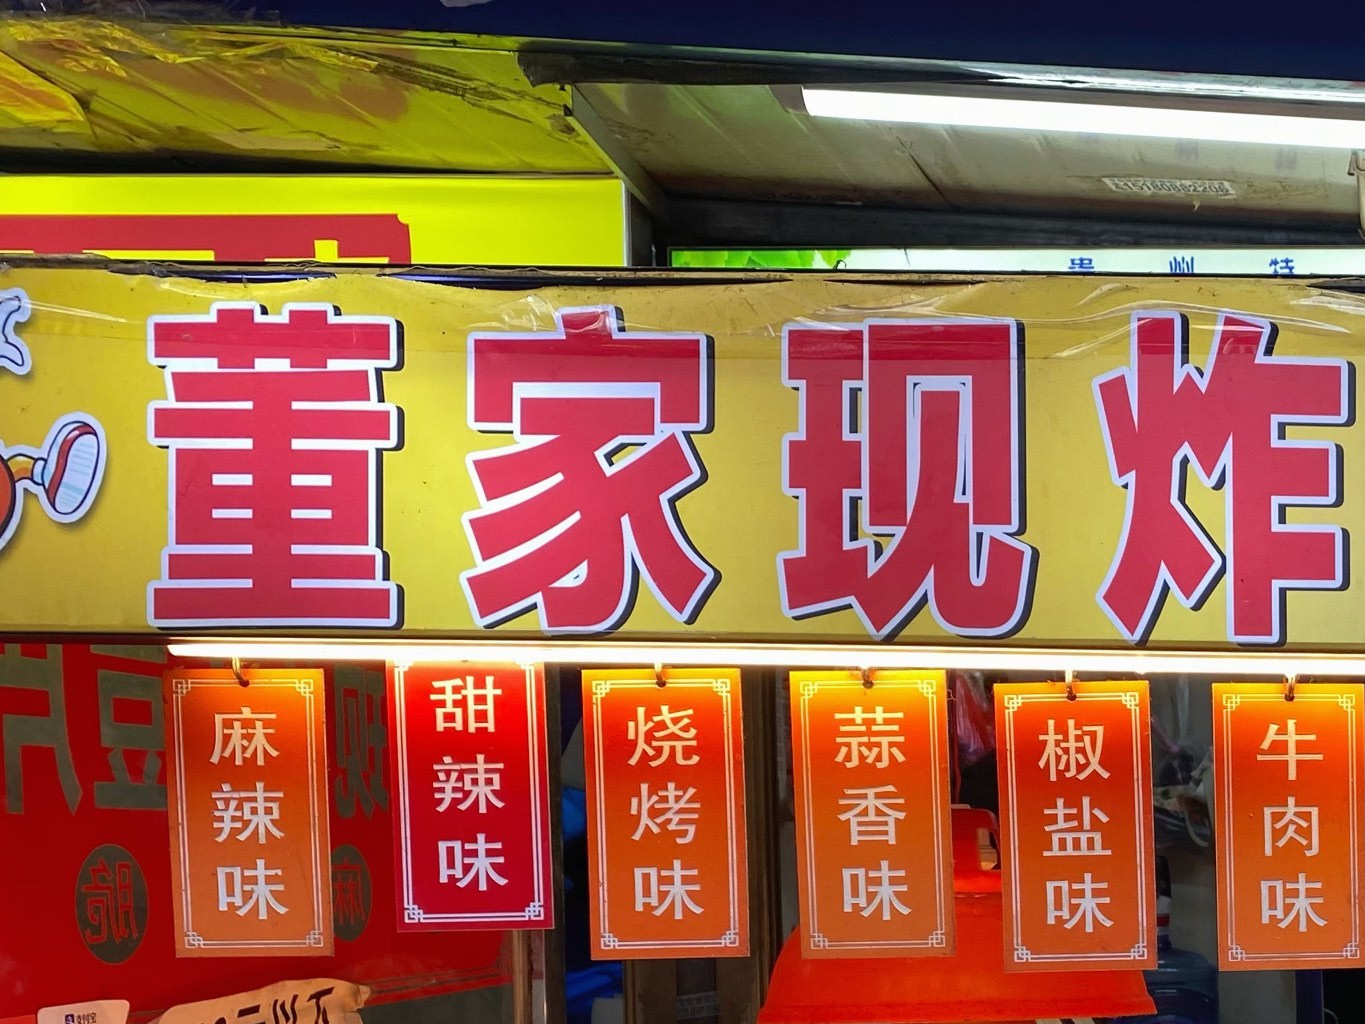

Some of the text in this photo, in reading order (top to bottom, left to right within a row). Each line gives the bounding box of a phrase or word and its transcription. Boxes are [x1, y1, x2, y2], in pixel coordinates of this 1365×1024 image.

[209, 706, 289, 920] 麻辣味
[430, 675, 508, 892] 甜辣味
[626, 705, 704, 920] 烧烤味
[834, 706, 912, 921] 蒜香味
[1037, 718, 1114, 933] 椒盐味
[1256, 718, 1328, 932] 牛肉味
